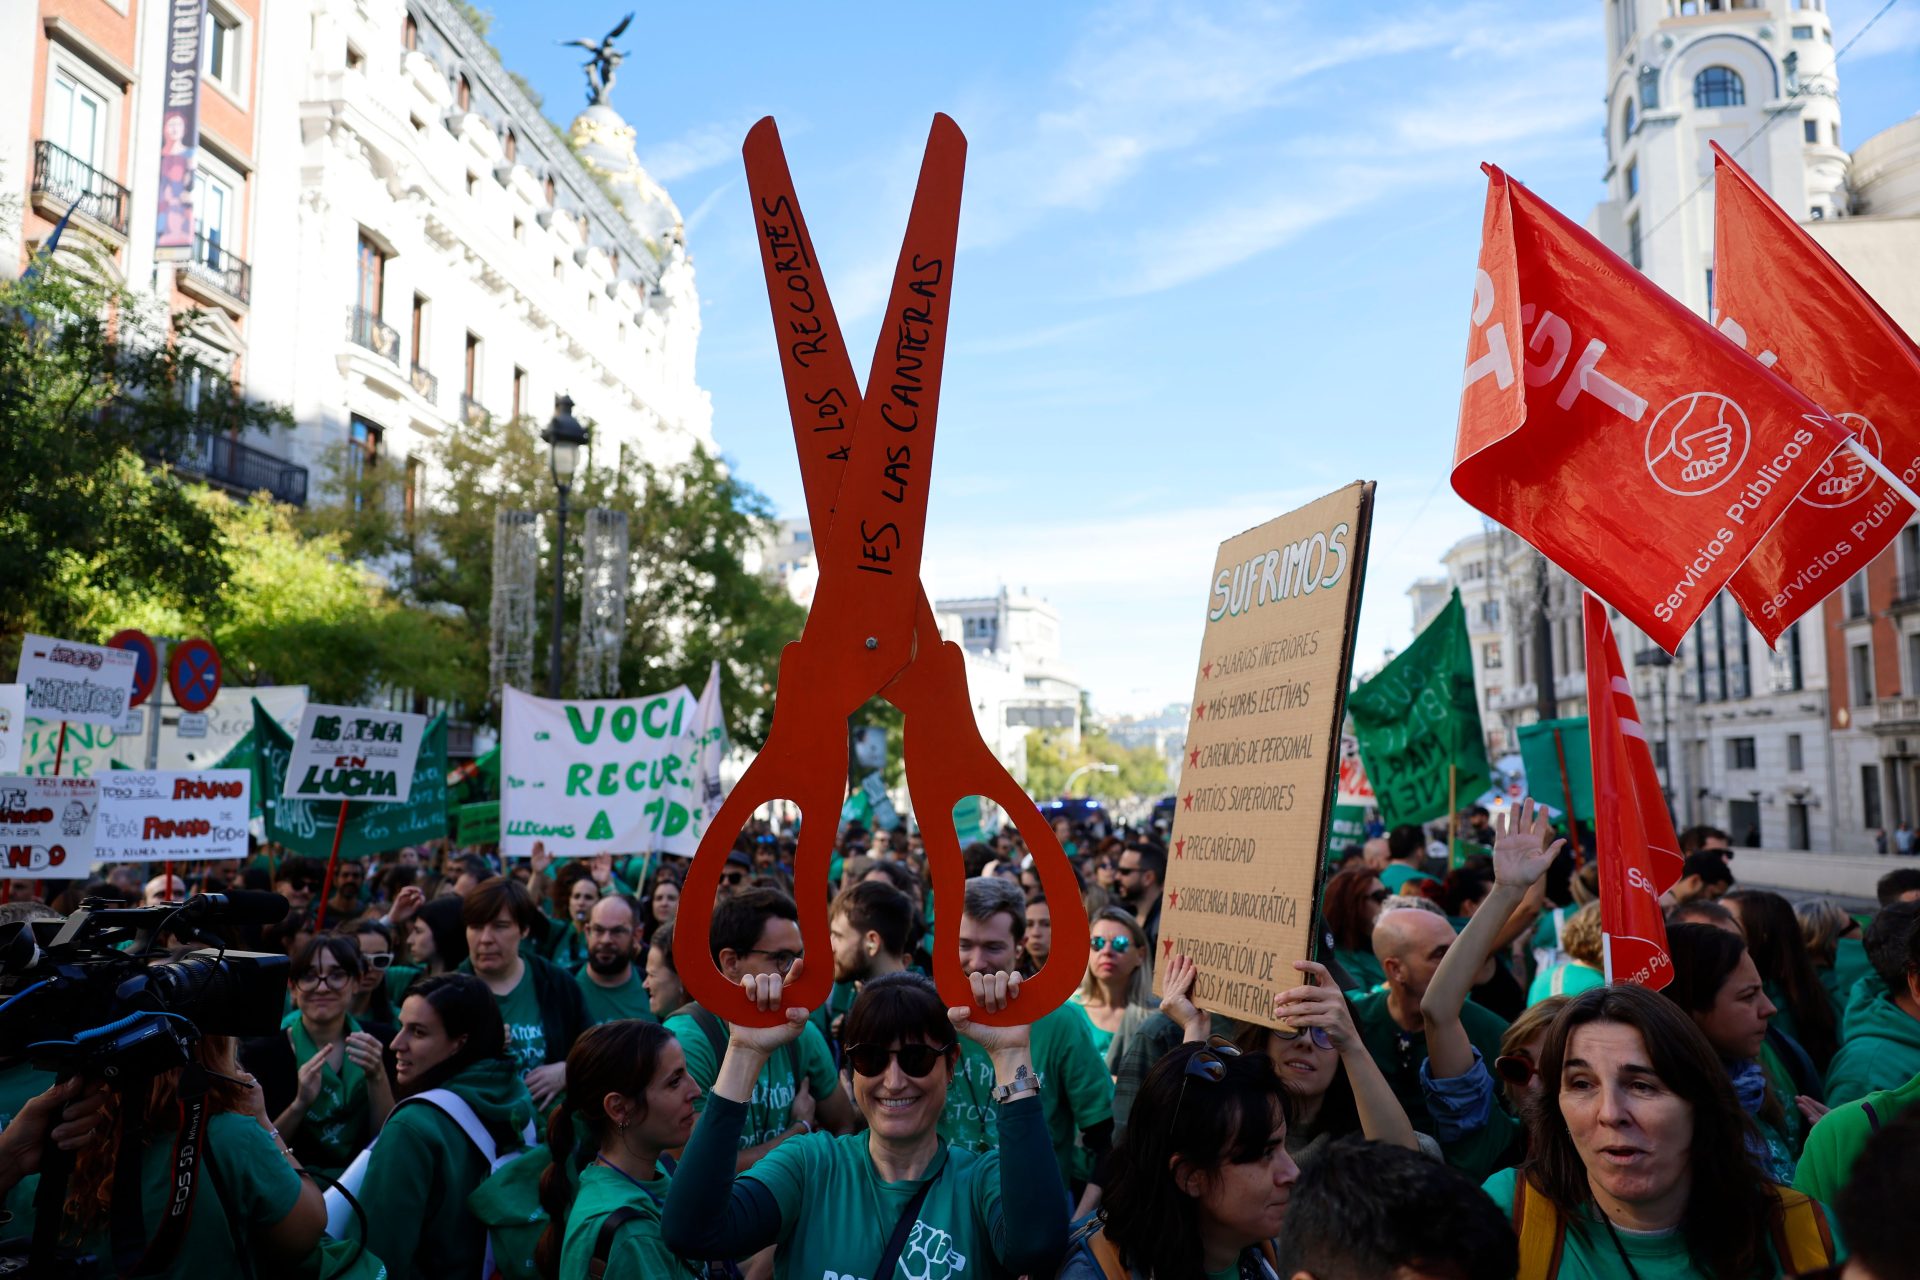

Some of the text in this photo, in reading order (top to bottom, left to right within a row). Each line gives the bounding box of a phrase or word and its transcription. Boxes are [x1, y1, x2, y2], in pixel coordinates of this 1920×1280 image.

[168, 69, 197, 107] NOS
[761, 195, 828, 368] RECORTES
[805, 387, 848, 432] LOS
[857, 253, 943, 575] IES LAS CANTERAS
[1654, 527, 1734, 623] Servicios
[1725, 428, 1814, 525] Públicos
[1761, 456, 1920, 620] Servicios Públios
[1209, 522, 1349, 622] SUFRIMOS
[1207, 678, 1311, 721] MÁS HORAS LECTIVAS
[334, 755, 368, 768] EN
[1246, 739, 1261, 764] DE
[1259, 733, 1313, 764] PERSONAL
[101, 787, 133, 799] TODO
[112, 775, 157, 787] CUANDO
[297, 765, 398, 797] LUCHA
[565, 753, 691, 797] RECUR
[1227, 781, 1296, 812] SUPERIORES
[1186, 831, 1256, 864] PRECARIEDAD
[1178, 885, 1297, 928] SOBRECARGA BUROCRÁTICA
[1258, 951, 1278, 982] DE
[1215, 976, 1225, 1002] Y
[1223, 980, 1288, 1022] MATERIAL
[180, 1144, 195, 1168] 5D
[171, 1171, 192, 1216] EOS
